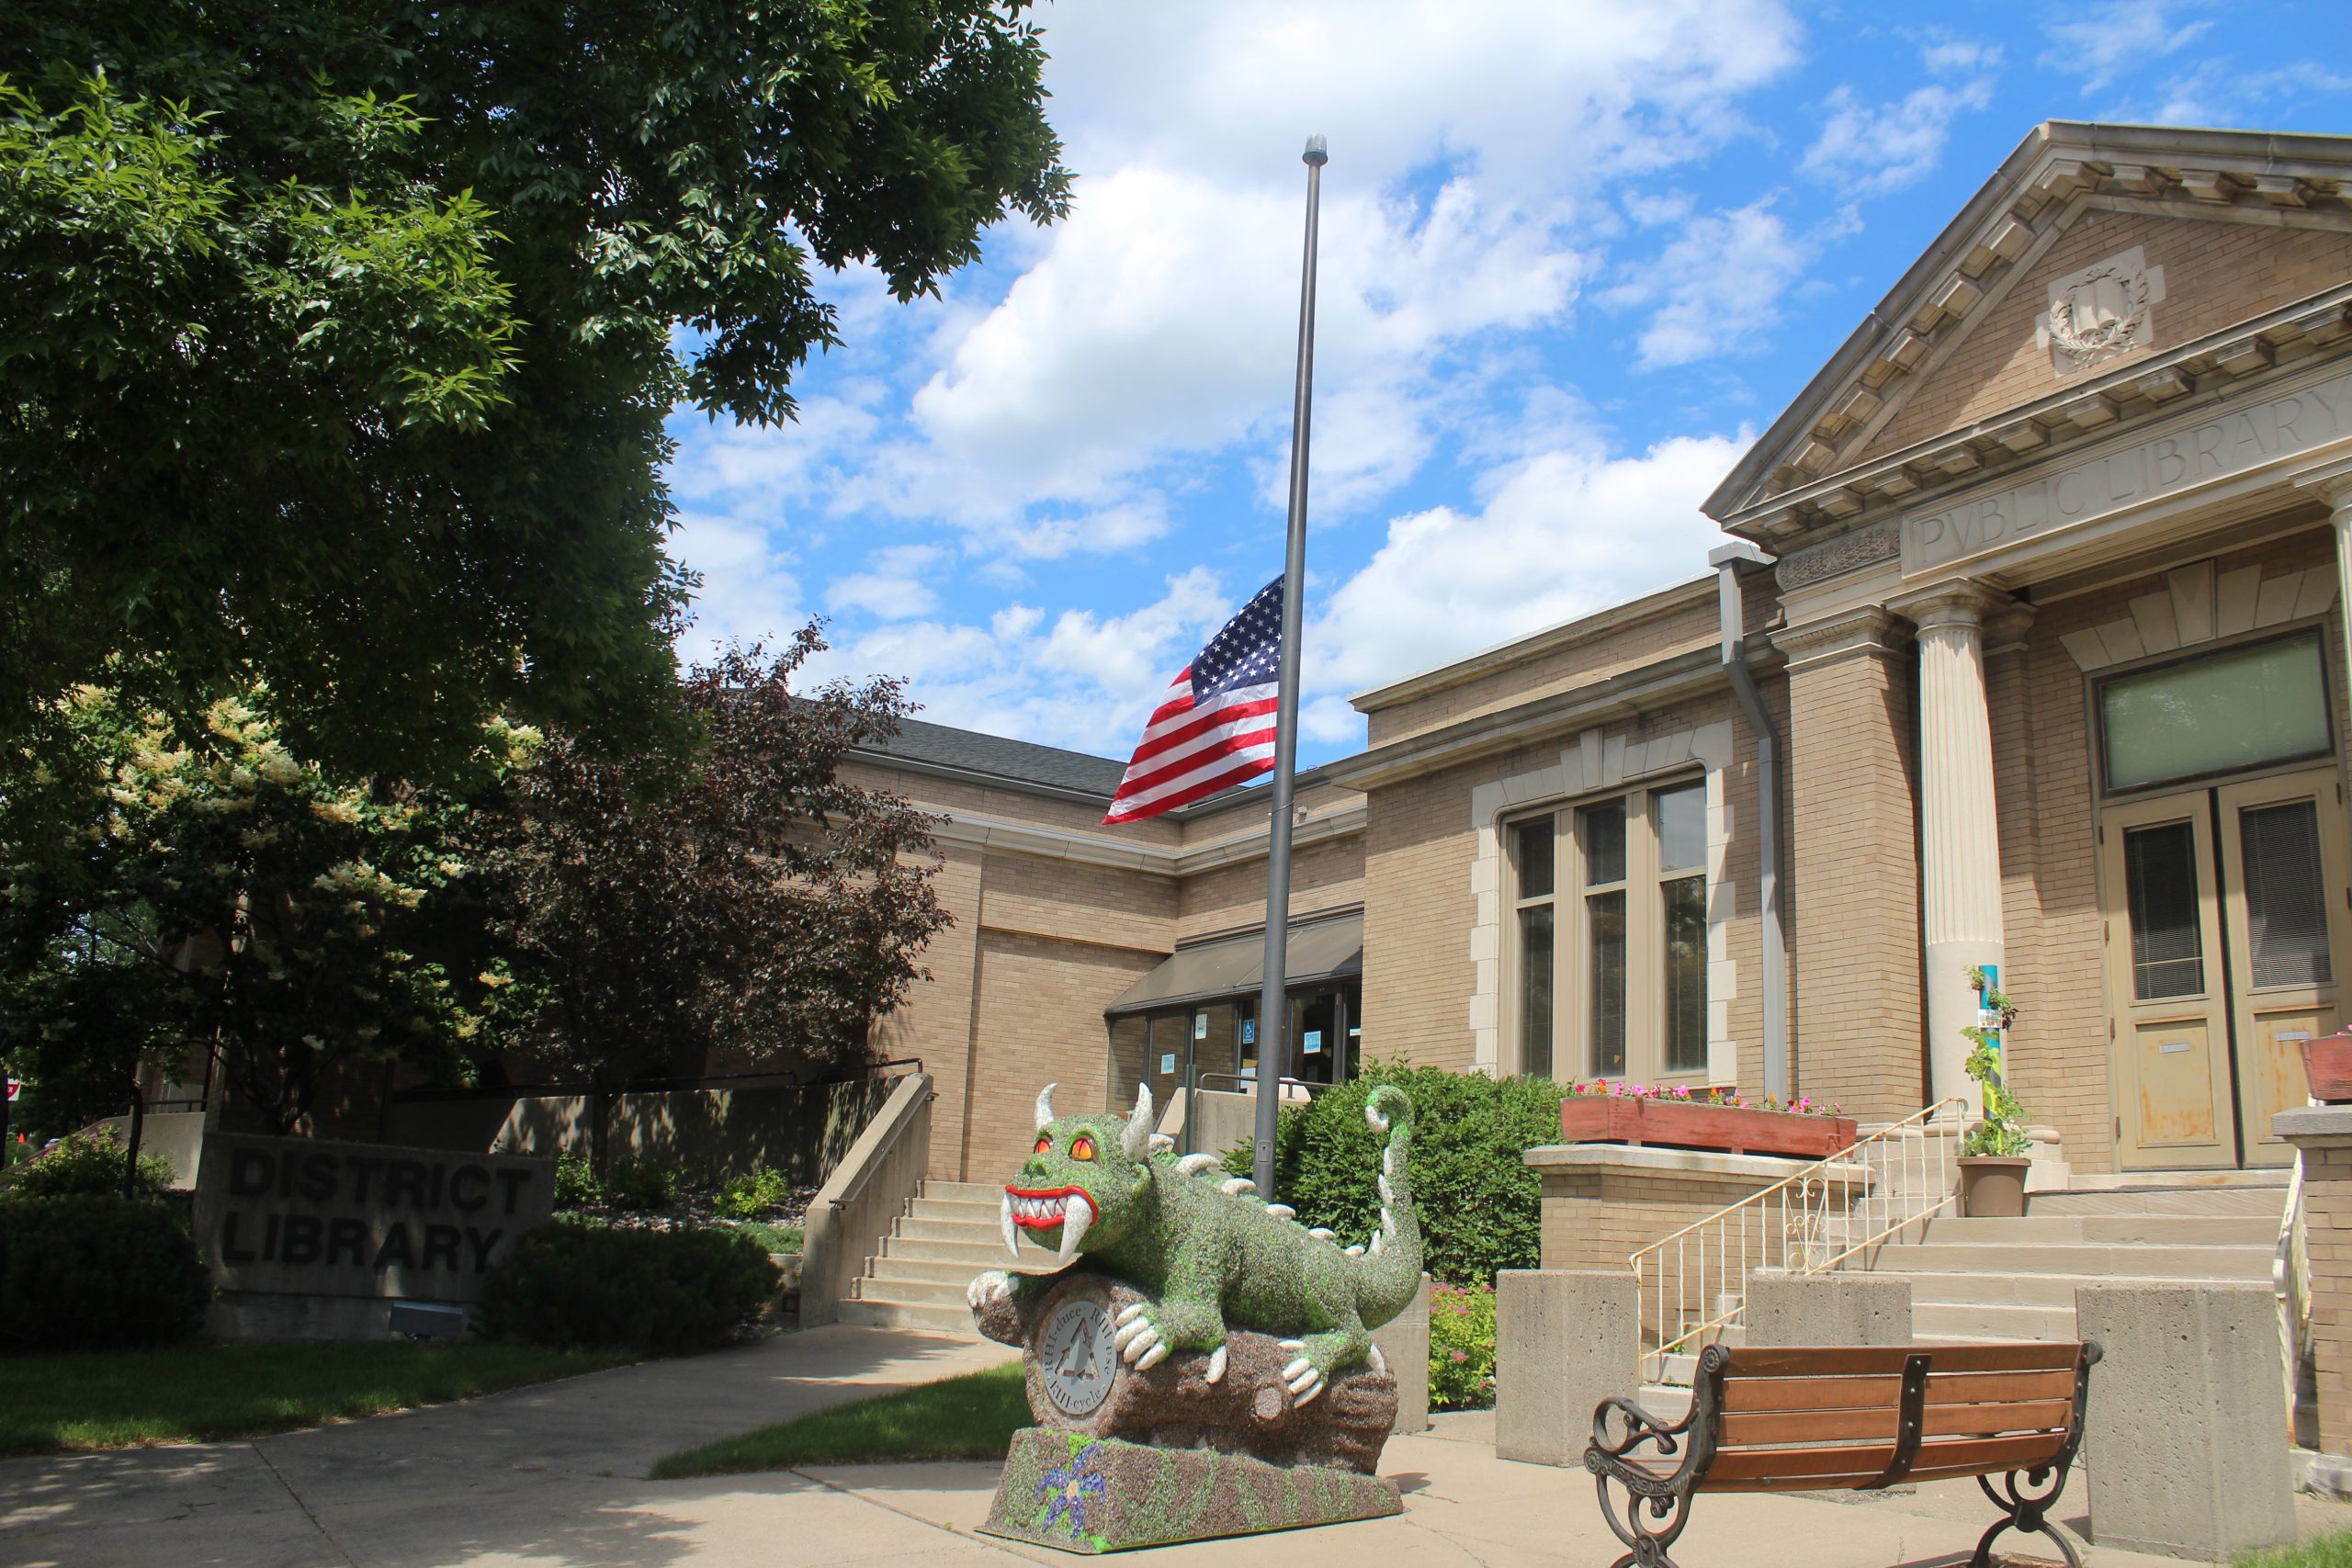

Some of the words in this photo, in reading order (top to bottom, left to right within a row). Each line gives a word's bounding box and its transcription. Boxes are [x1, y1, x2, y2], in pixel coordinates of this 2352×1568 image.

[1919, 471, 2086, 563] PVBLIC
[2102, 377, 2352, 502] LIBRARY
[230, 1147, 533, 1215] DISTRICT
[221, 1211, 503, 1274] LIBRARY
[1044, 1307, 1081, 1371] RHI-duce
[1090, 1307, 1114, 1375] RHIuse
